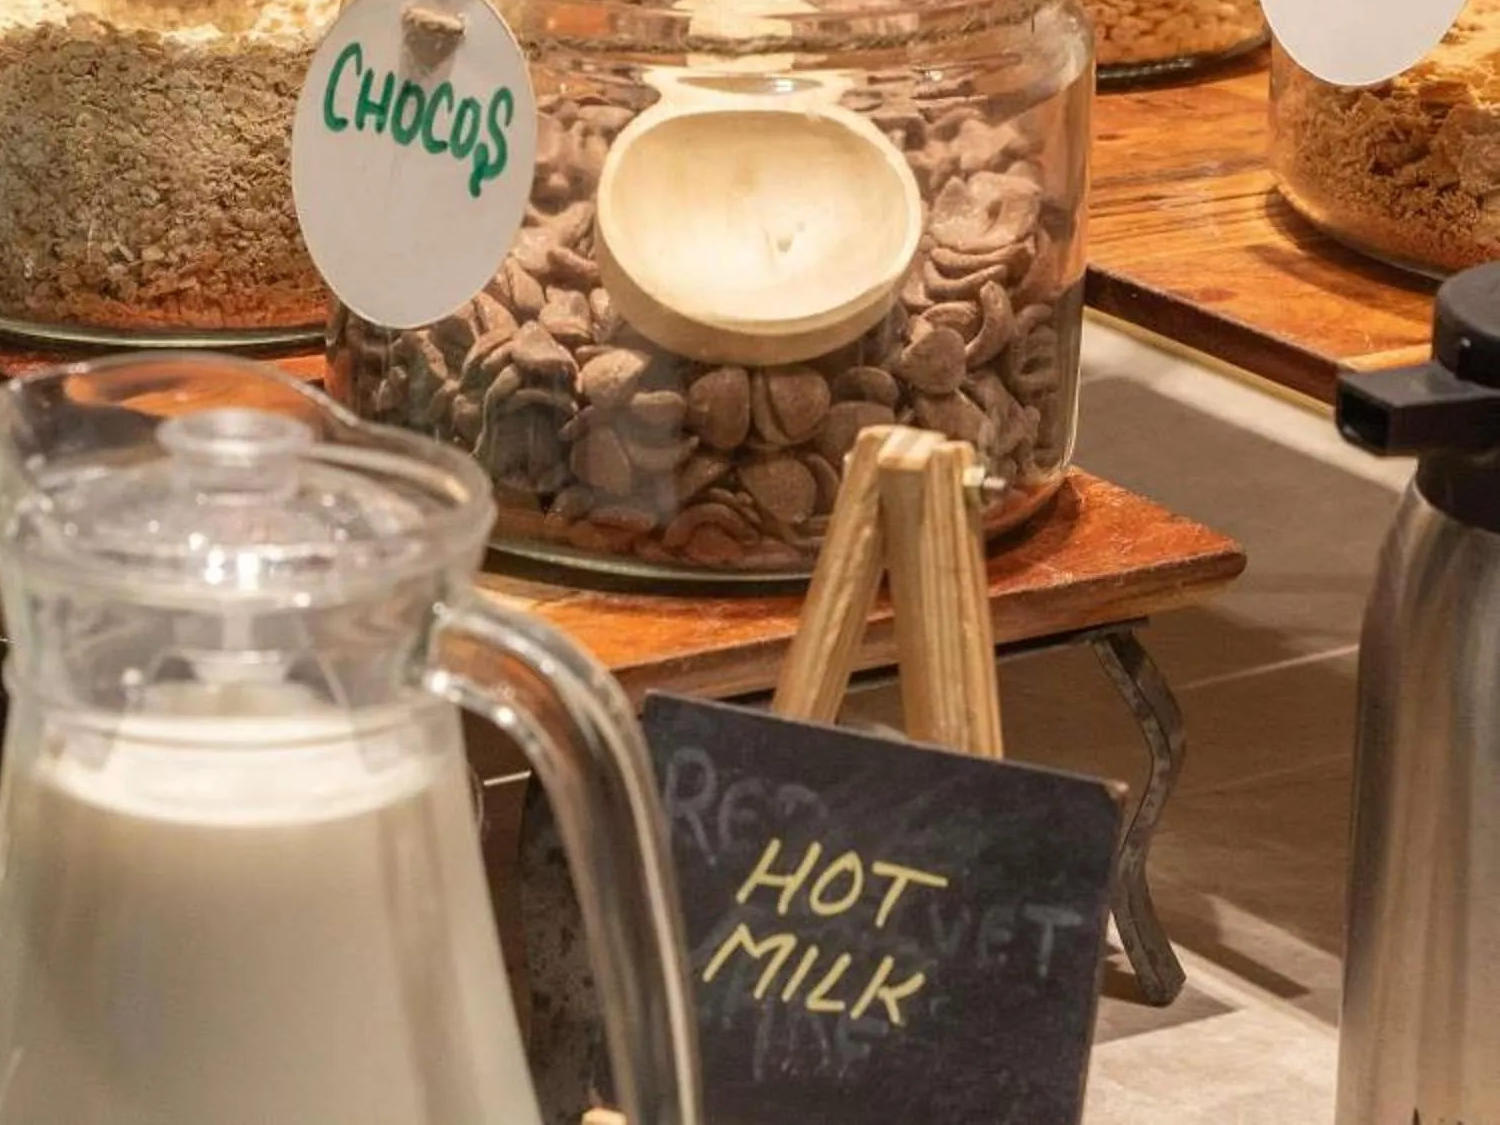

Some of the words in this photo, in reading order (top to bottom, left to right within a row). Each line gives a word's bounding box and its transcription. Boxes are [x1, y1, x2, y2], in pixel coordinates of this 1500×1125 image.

[322, 40, 515, 199] CHOCOS
[736, 837, 949, 929] HOT
[702, 923, 927, 1027] MILK
